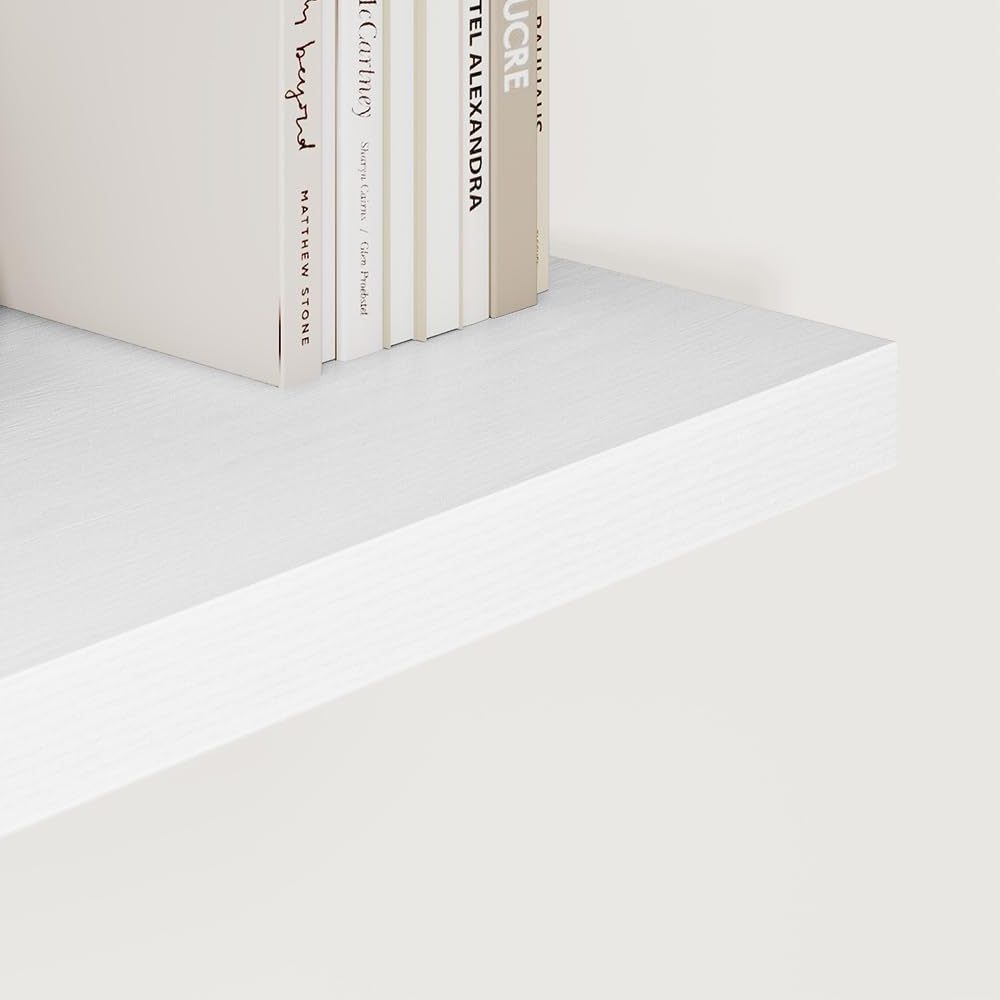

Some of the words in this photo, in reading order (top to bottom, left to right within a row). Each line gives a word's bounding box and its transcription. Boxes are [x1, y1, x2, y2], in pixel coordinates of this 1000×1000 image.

[284, 40, 316, 151] beyond
[469, 53, 483, 212] ALEXANDRA
[301, 189, 310, 278] MATTHEW
[359, 182, 369, 221] Cairns
[301, 287, 310, 346] STONE
